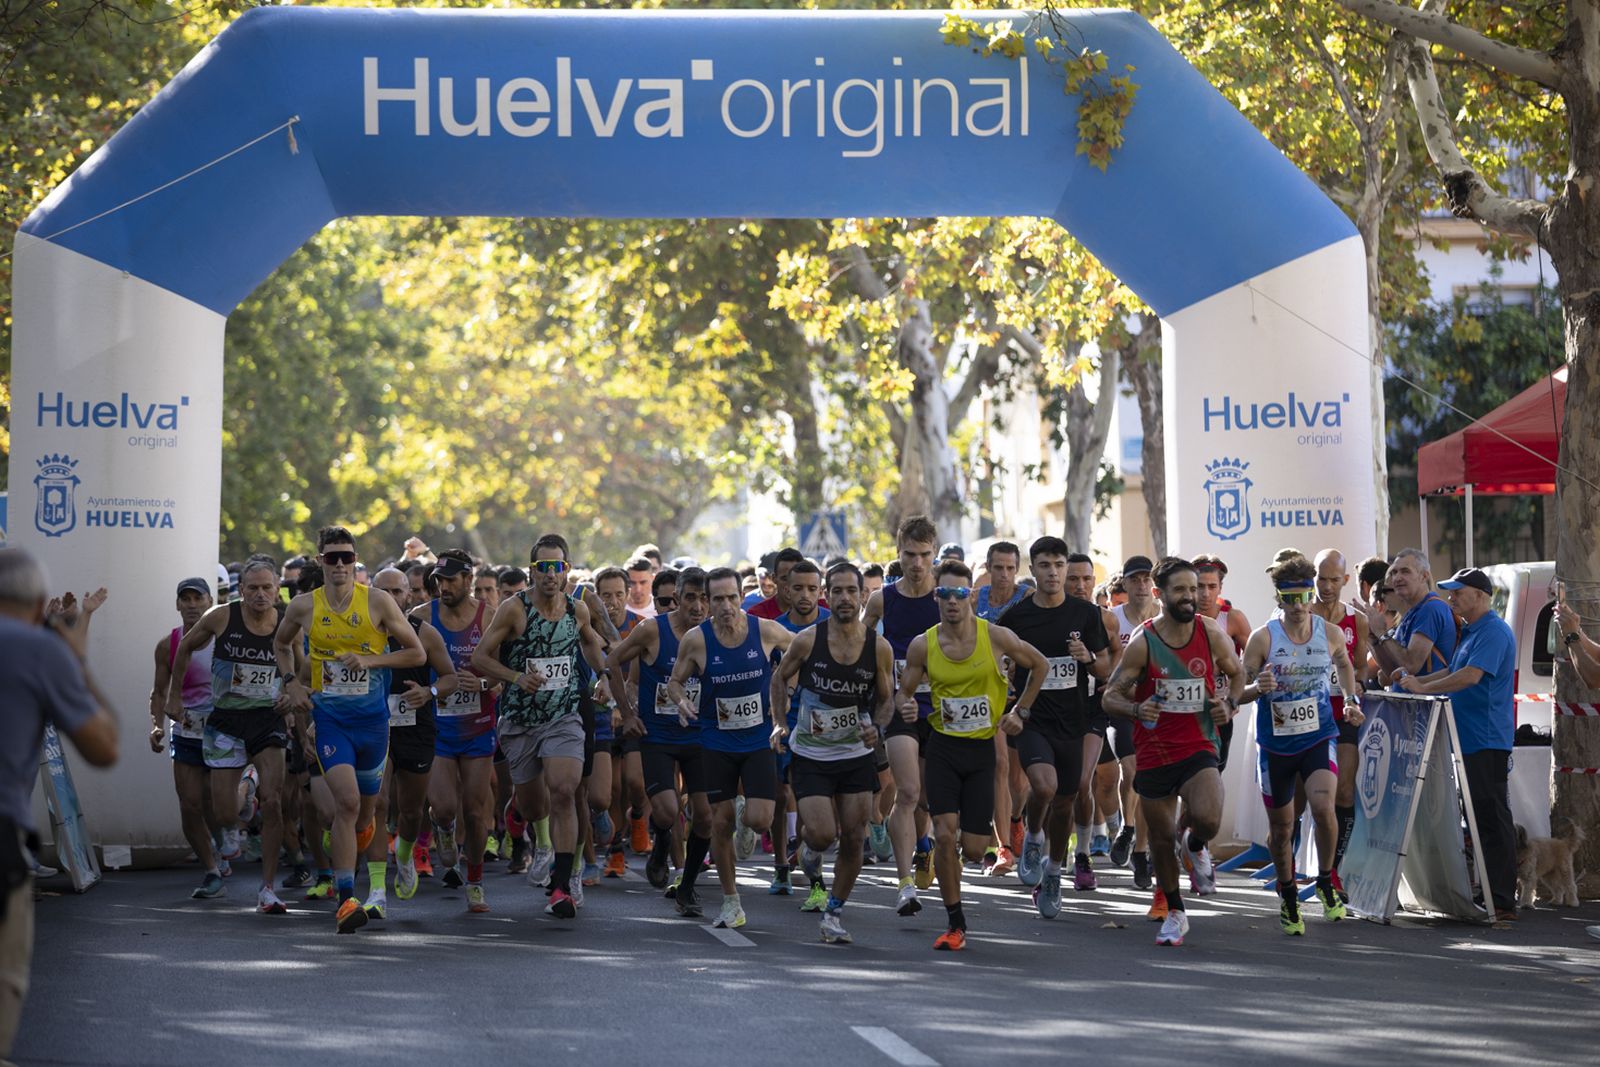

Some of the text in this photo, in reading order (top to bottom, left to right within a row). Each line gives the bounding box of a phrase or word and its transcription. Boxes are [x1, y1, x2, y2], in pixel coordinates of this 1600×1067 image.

[363, 56, 1029, 158] Huelva original
[37, 391, 179, 430] Huelva
[1203, 391, 1342, 432] Huelva
[127, 434, 178, 450] original
[1297, 432, 1343, 448] original
[87, 495, 176, 508] Ayuntamiento de
[1261, 495, 1344, 508] Ayuntamiento de
[86, 510, 174, 529] HUELVA
[1261, 509, 1344, 528] HUELVA
[250, 670, 272, 685] 251
[340, 667, 367, 683] 302
[545, 662, 569, 679] 376
[1052, 662, 1076, 678] 139
[1176, 684, 1201, 701] 311
[734, 700, 758, 717] 469
[960, 701, 988, 720] 246
[1289, 704, 1315, 722] 496
[831, 712, 857, 730] 388
